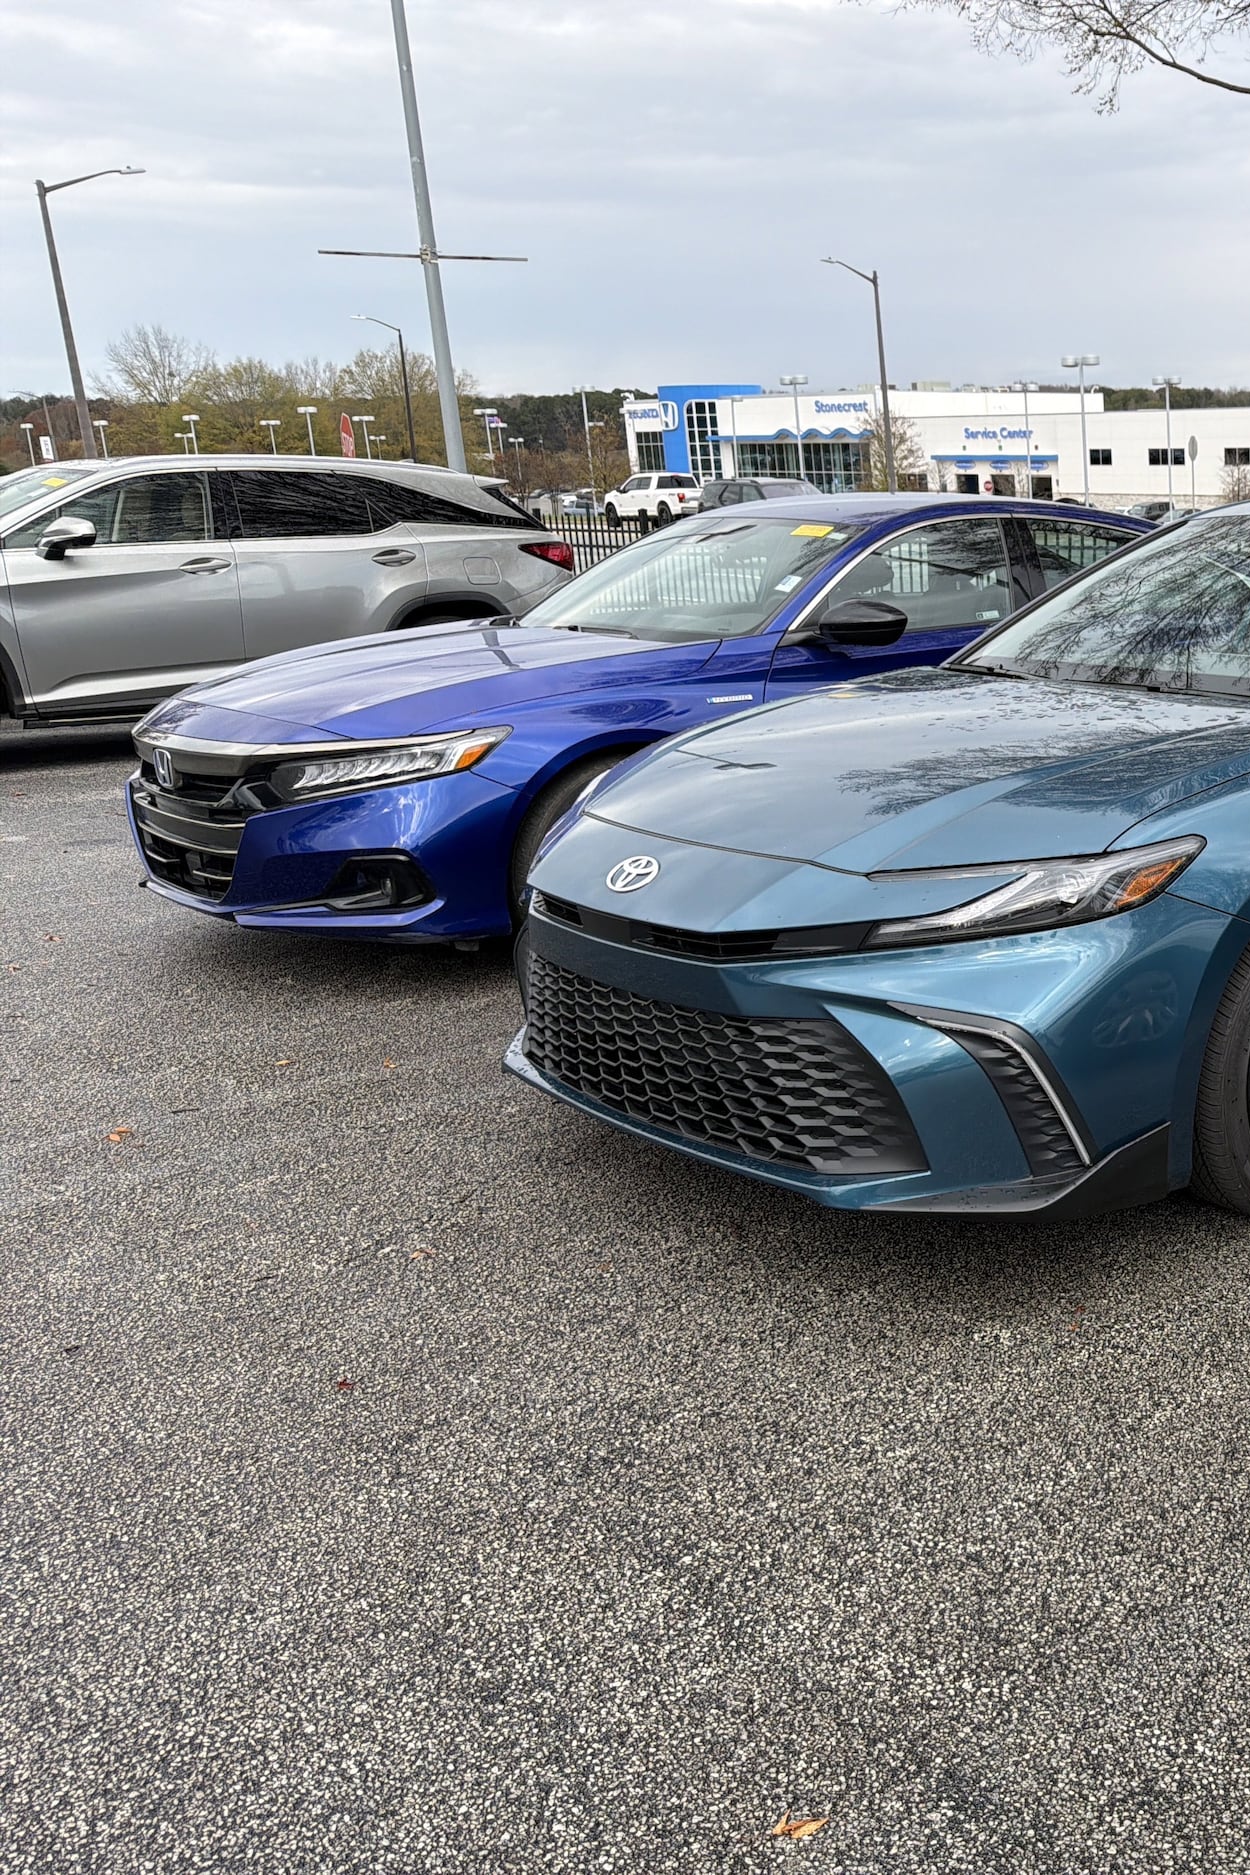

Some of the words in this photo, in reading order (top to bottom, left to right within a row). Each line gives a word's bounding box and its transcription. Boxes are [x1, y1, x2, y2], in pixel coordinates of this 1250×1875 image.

[814, 400, 869, 413] Stonecrest
[627, 409, 660, 419] HOND
[964, 427, 998, 440] Service
[999, 427, 1034, 440] Center
